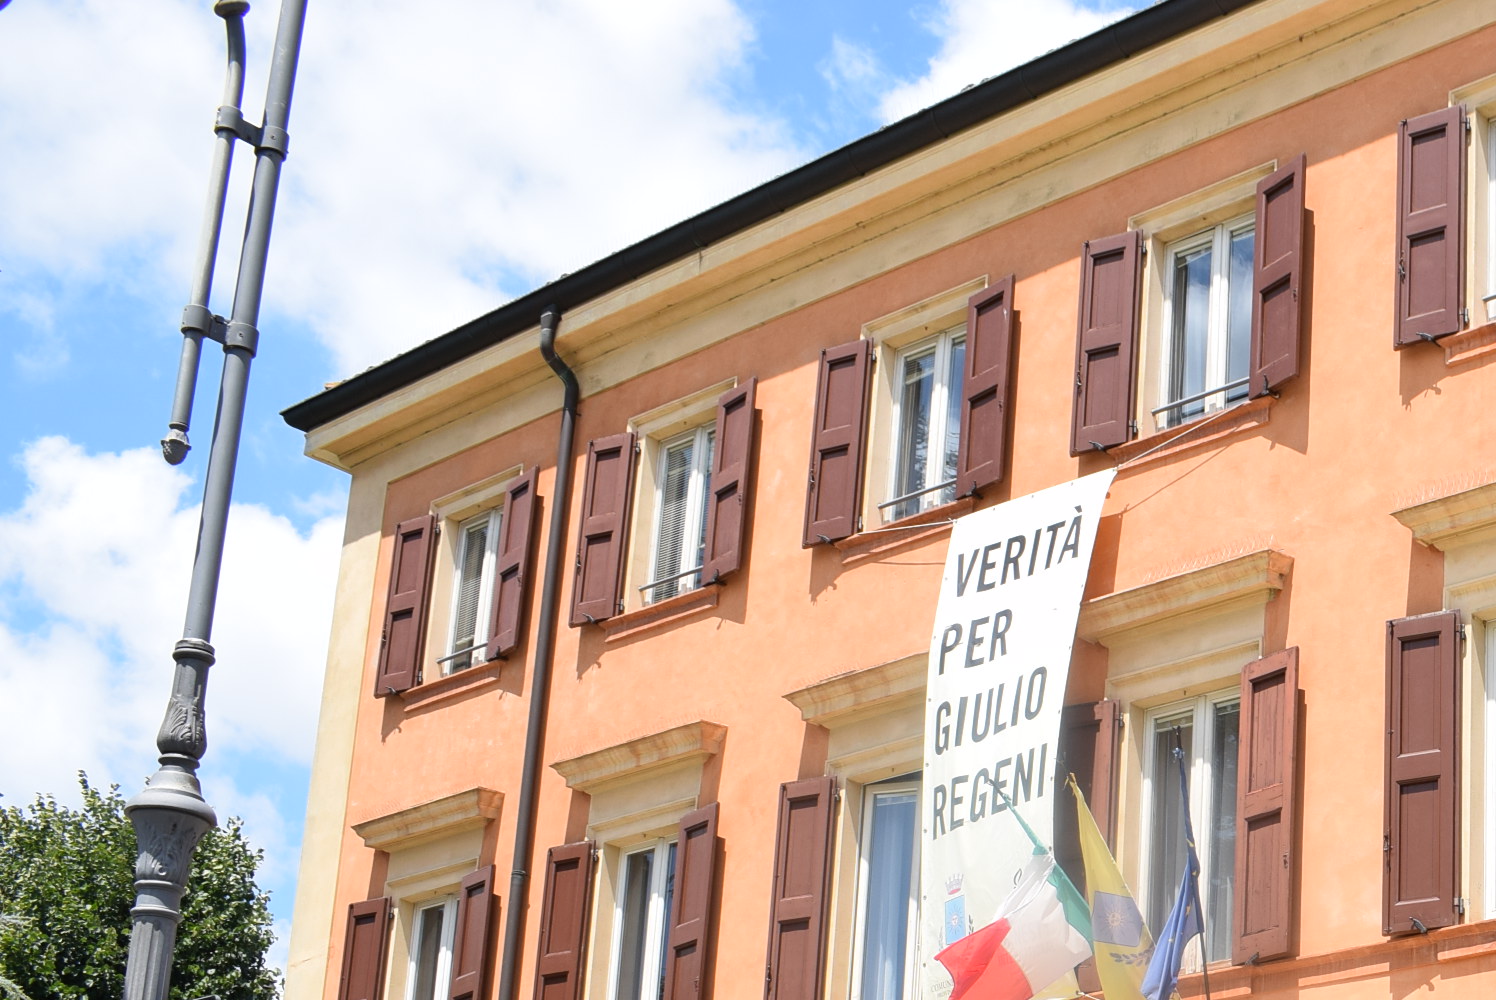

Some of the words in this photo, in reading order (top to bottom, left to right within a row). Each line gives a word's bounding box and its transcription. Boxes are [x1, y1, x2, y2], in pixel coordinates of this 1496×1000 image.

[957, 505, 1083, 598] VERITÀ
[938, 608, 1013, 676] PER
[934, 666, 1048, 756] GIULIO
[932, 743, 1048, 840] REGENI
